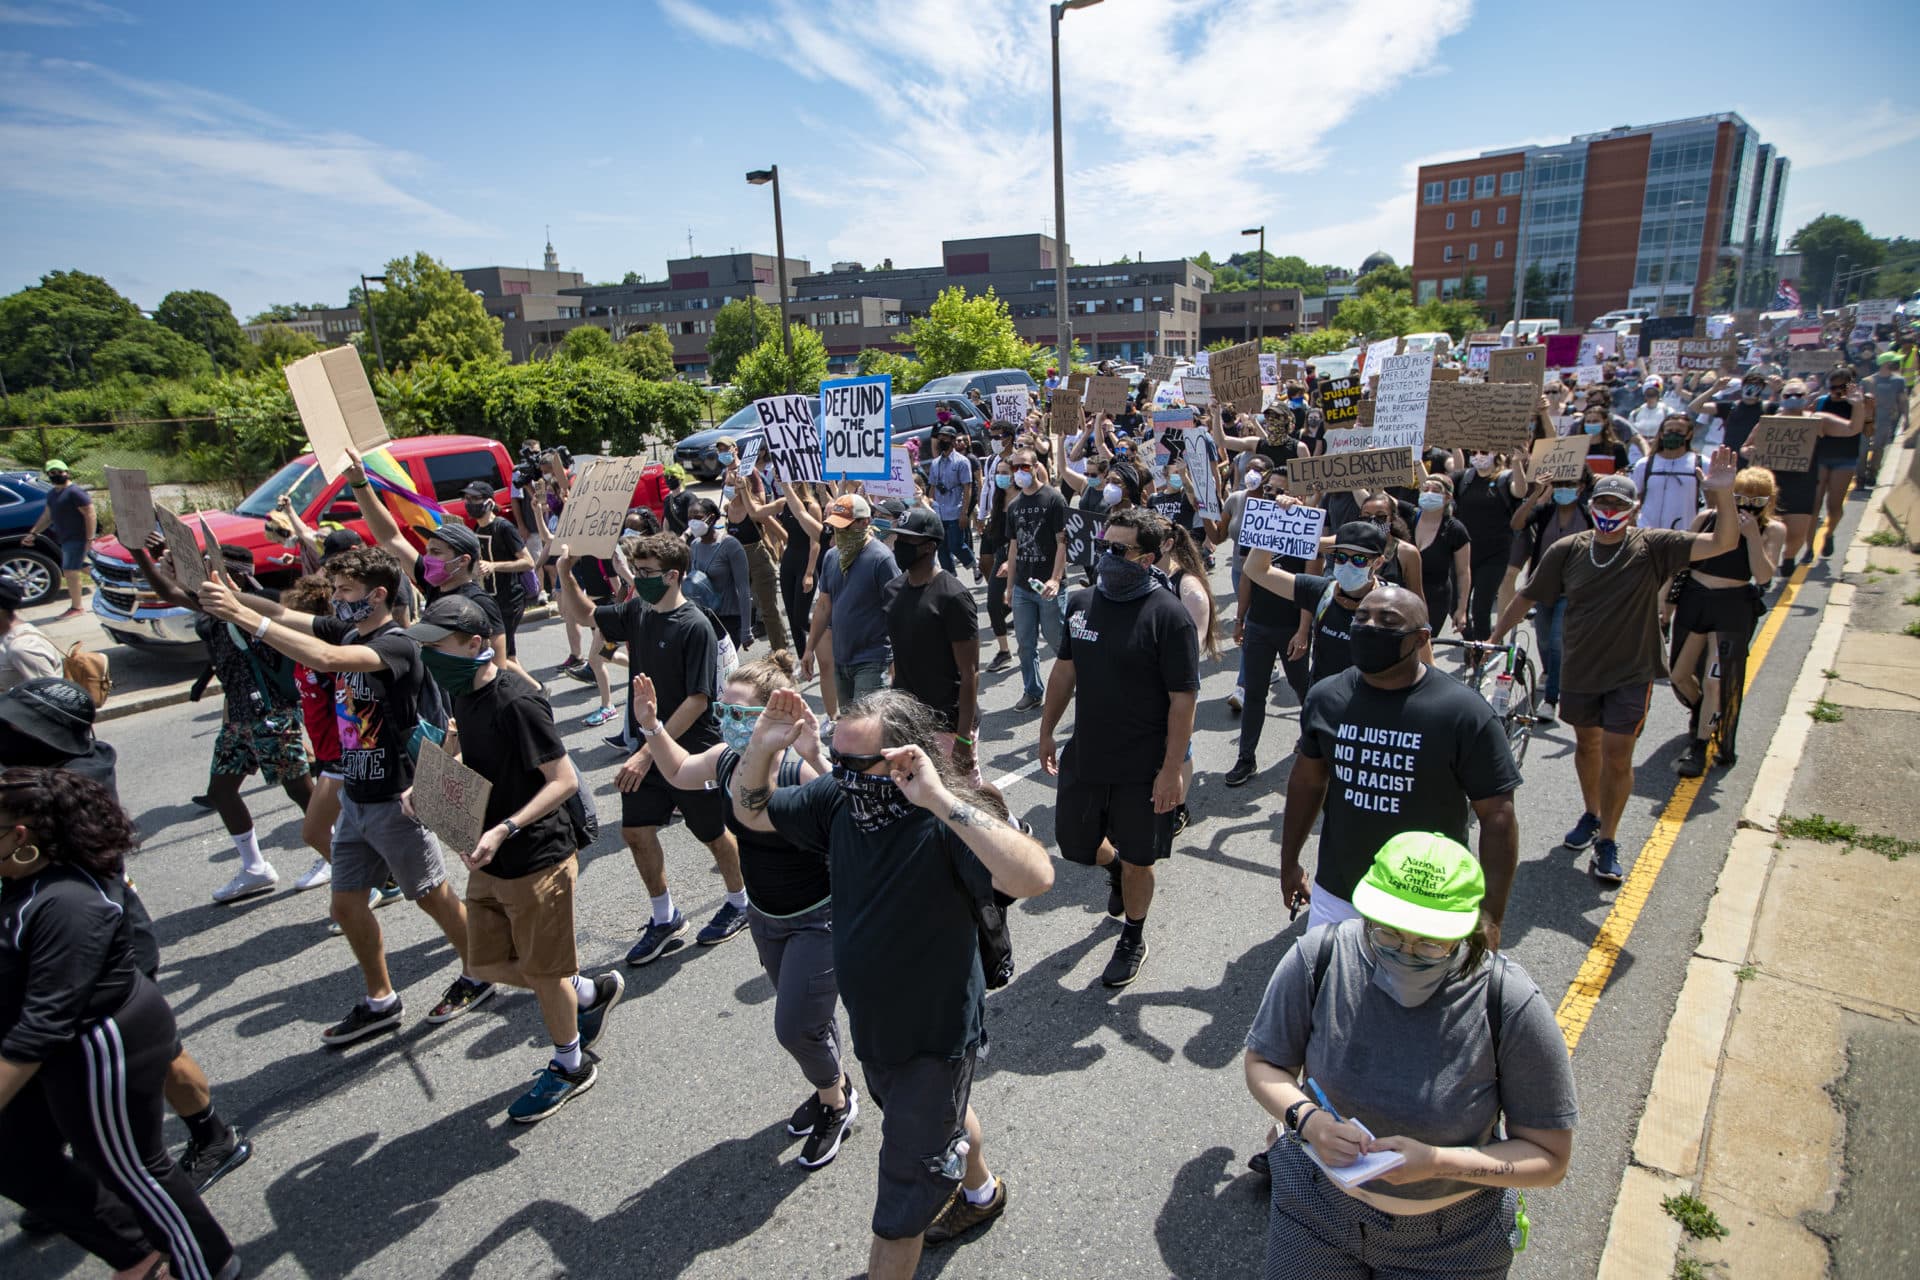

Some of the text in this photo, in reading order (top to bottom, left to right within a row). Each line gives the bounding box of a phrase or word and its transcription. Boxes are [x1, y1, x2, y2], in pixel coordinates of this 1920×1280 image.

[1222, 361, 1246, 381] THE
[1412, 356, 1431, 367] PLUS
[1681, 356, 1722, 369] POLICE
[1215, 375, 1260, 402] INNOCENT
[1323, 386, 1361, 401] JUSTICE
[1331, 379, 1350, 391] NO
[825, 385, 884, 418] DEFUND
[995, 395, 1021, 407] BLACK
[1334, 397, 1351, 409] NO
[1399, 392, 1413, 402] NOT
[757, 396, 815, 427] BLACK
[999, 405, 1019, 414] LIVES
[1326, 406, 1359, 421] PEACE
[841, 418, 865, 431] THE
[764, 424, 820, 450] LIVES
[826, 428, 885, 459] POLICE
[1373, 431, 1424, 447] BLACK LIVES
[1765, 427, 1808, 443] BLACK
[1553, 440, 1565, 450] I
[1767, 442, 1801, 457] LIVES
[1350, 449, 1413, 475] BREATHE
[1752, 454, 1809, 472] MATTER
[573, 464, 594, 498] No
[558, 496, 623, 537] No Peace
[1065, 513, 1085, 539] NO
[1243, 513, 1317, 536] POLICE
[1270, 513, 1283, 521] the
[1068, 538, 1085, 562] NO
[1337, 723, 1422, 750] NO JUSTICE
[1334, 743, 1415, 772] NO PEACE
[1335, 764, 1415, 792] NO RACIST
[1344, 788, 1400, 813] POLICE
[1400, 863, 1446, 881] Lawyers
[1403, 855, 1446, 875] National
[1389, 876, 1449, 900] Legal Observer
[1403, 873, 1437, 890] Guild
